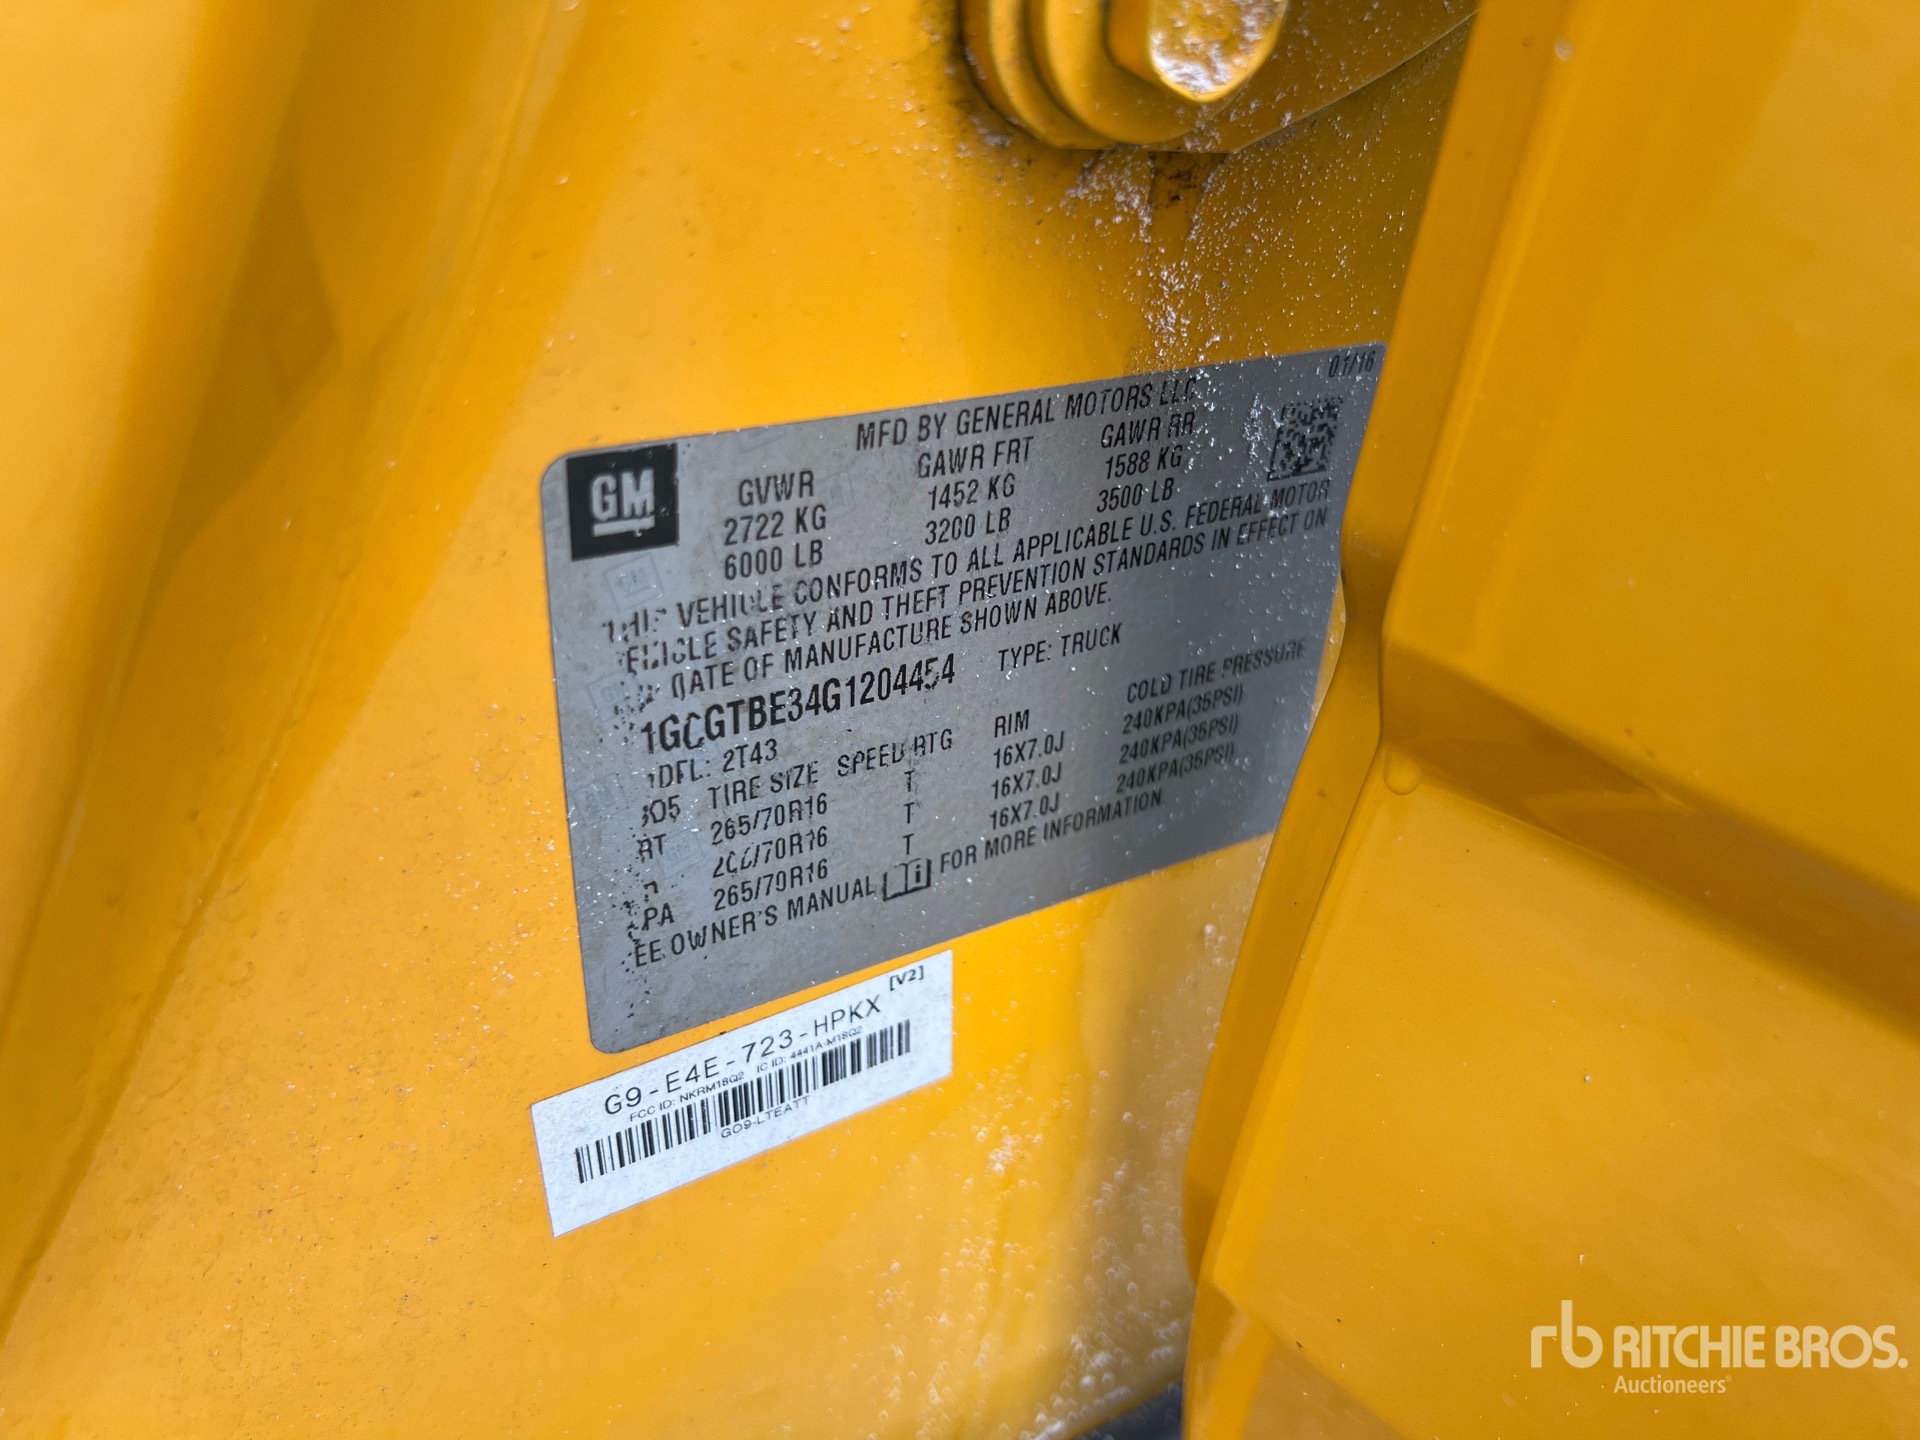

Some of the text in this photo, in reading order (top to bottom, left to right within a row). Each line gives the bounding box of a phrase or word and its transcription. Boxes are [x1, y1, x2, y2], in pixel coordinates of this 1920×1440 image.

[1328, 351, 1377, 378] 01/16
[856, 378, 1197, 450] MFD BY GENERAL MOTORS LLC
[1101, 411, 1196, 448] GAWR RR
[917, 436, 1034, 479] GAWR FRT
[1105, 445, 1183, 480] 1588 KG
[591, 467, 655, 522] GM
[739, 470, 814, 506] GVWR
[928, 473, 1016, 511] 1452 KG
[1097, 477, 1174, 513] 3500 LB
[724, 505, 826, 546] 2722 KG
[794, 558, 922, 605] CONFORMS
[932, 552, 958, 578] TO
[967, 538, 1003, 573] ALL
[1013, 517, 1132, 564] APPLICABLE
[1140, 510, 1176, 538] U.S.
[1185, 492, 1262, 529] FEDERAL
[1269, 479, 1331, 511] MOTOR
[924, 507, 1011, 545] 3200 LB
[724, 540, 823, 580] 6000 LB
[617, 506, 1328, 674] EHICLE SAFETY AND THEFT PREVENTION STANDARDS IN EFFECT ON
[671, 662, 733, 701] DATE
[743, 653, 774, 682] OF
[785, 615, 951, 673] MANUFACTURE
[960, 596, 1036, 634] SHOWN
[1045, 581, 1112, 616] ABOVE.
[999, 623, 1123, 672] TYPE: TRUCK
[1127, 640, 1306, 704] COLD TIRE PRESSURE
[641, 653, 955, 754] 1GCGTBE34G1204454
[994, 710, 1030, 738] RIM
[1122, 683, 1243, 735] 240KPA(35PSI)
[723, 738, 777, 772] 2T43
[838, 728, 952, 777] SPEED RTG
[993, 732, 1064, 769] 16X7.0J
[1119, 713, 1238, 765] 240KPA(35PSI)
[708, 776, 760, 809] TIRE
[770, 761, 818, 793] SIZE
[904, 770, 914, 792] T
[991, 762, 1062, 801] 16X7.0J
[1116, 742, 1234, 794] 240KPA(35PSI)
[710, 792, 827, 845] 265/70R16
[903, 802, 914, 824] T
[989, 792, 1060, 831] 16X7.0J
[902, 834, 914, 856] T
[671, 904, 777, 955] OWNER'S
[788, 877, 875, 921] MANUAL
[940, 844, 976, 874] FOR
[985, 827, 1037, 859] MORE
[1044, 790, 1163, 841] INFORMATION
[713, 858, 828, 911] 265/70R16
[889, 965, 925, 992] [V2]
[605, 993, 882, 1115] G9-E4E-723-HPKX
[756, 1025, 864, 1073] IC ID: 4441A-M18Q2
[630, 1071, 745, 1122] FCC ID: NKRM18Q2
